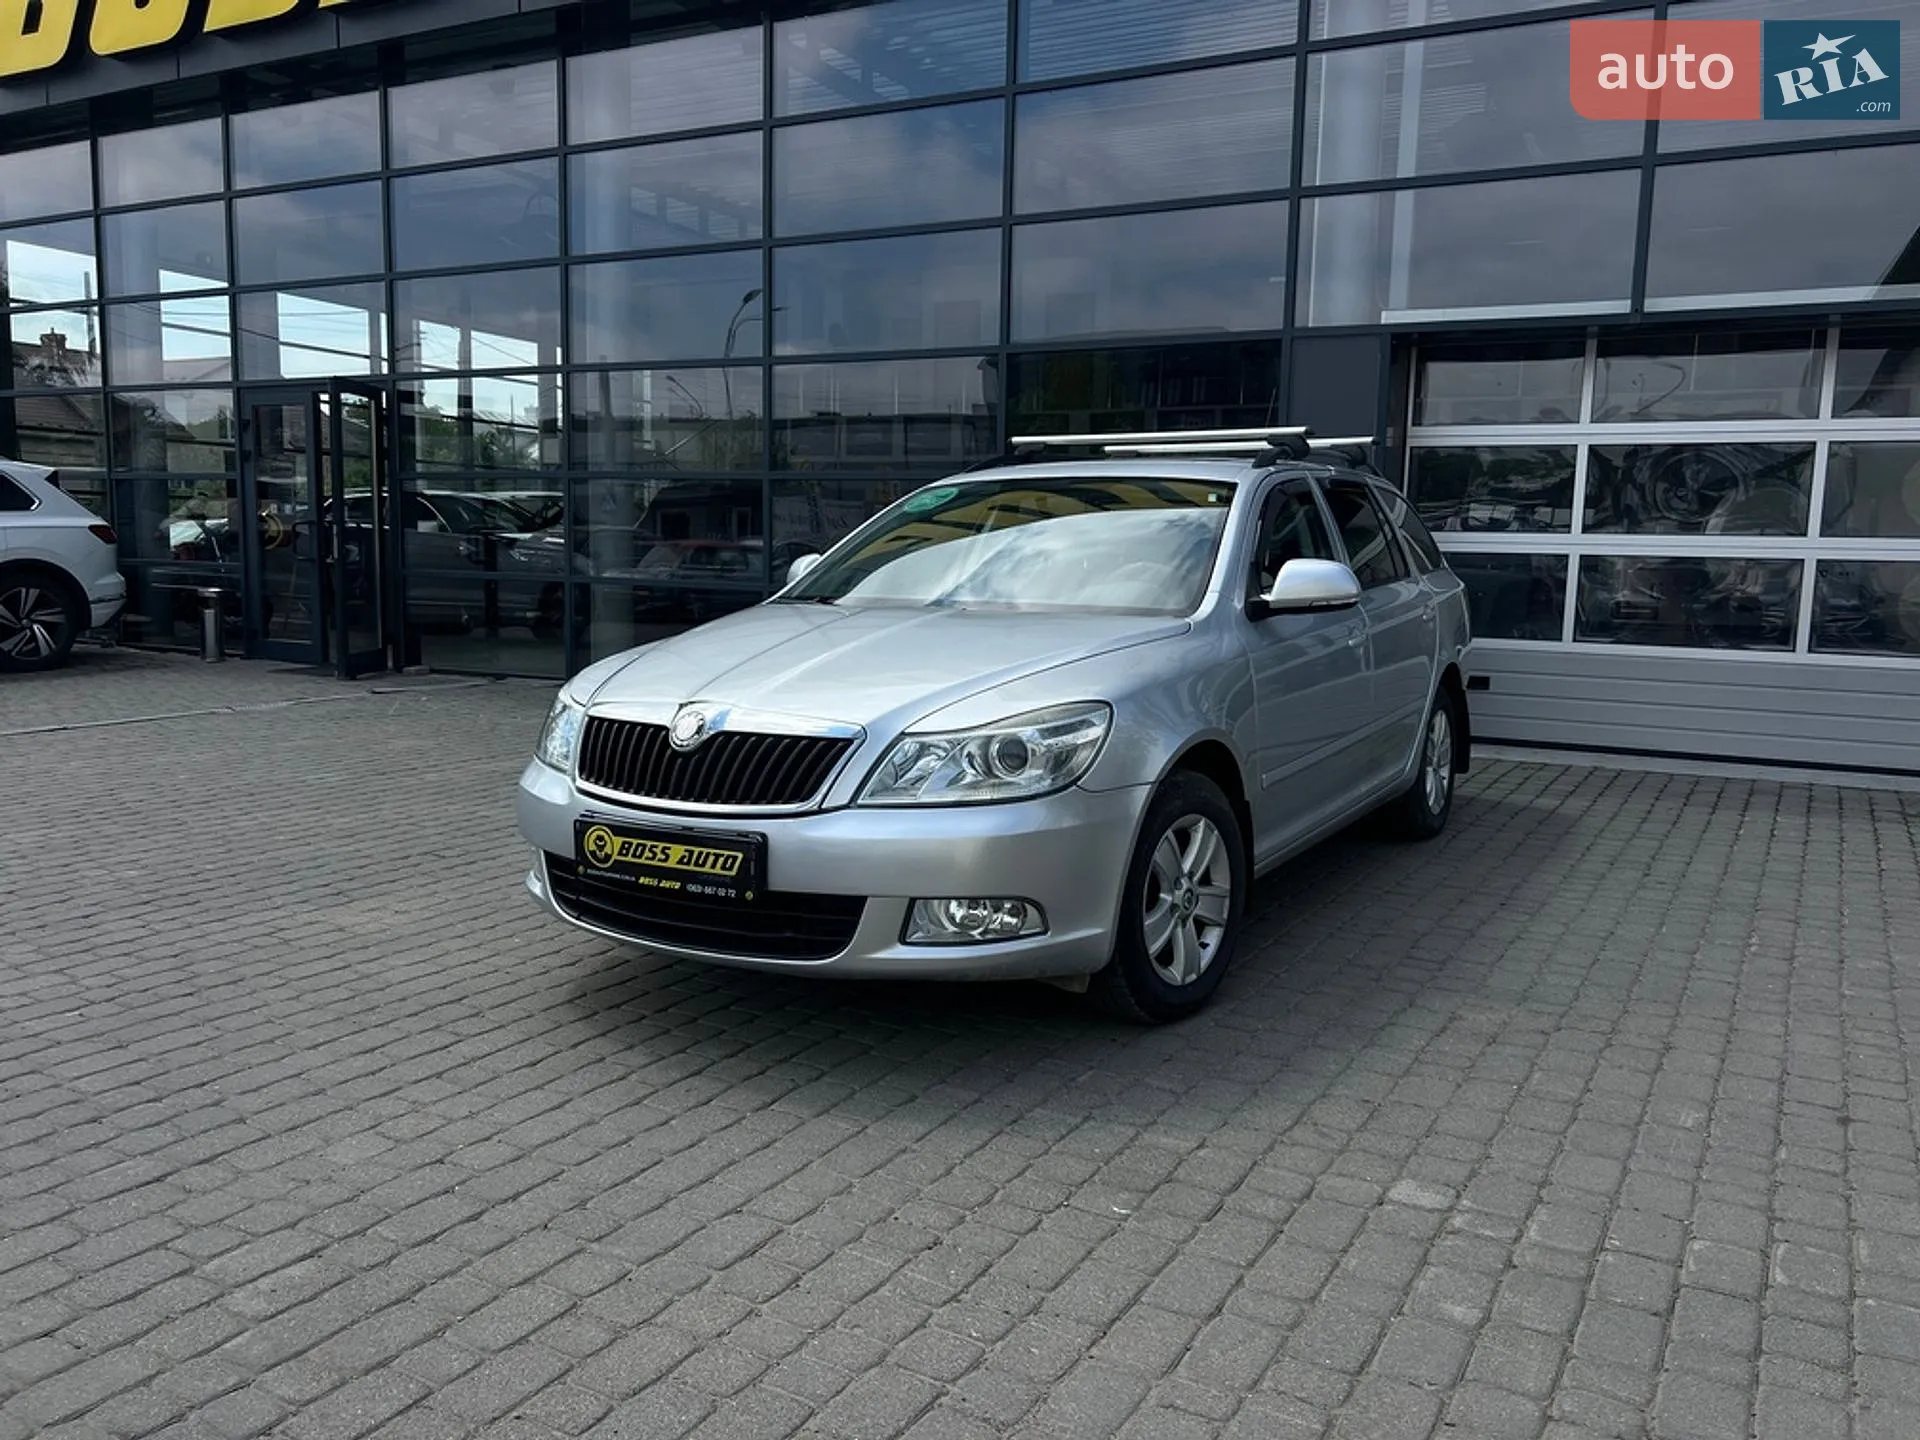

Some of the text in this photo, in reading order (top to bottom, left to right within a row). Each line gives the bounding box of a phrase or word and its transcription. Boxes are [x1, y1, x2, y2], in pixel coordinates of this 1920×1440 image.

[617, 841, 739, 872] BOSS AUTO
[638, 876, 659, 886] BOSS
[659, 880, 682, 889] AUTO
